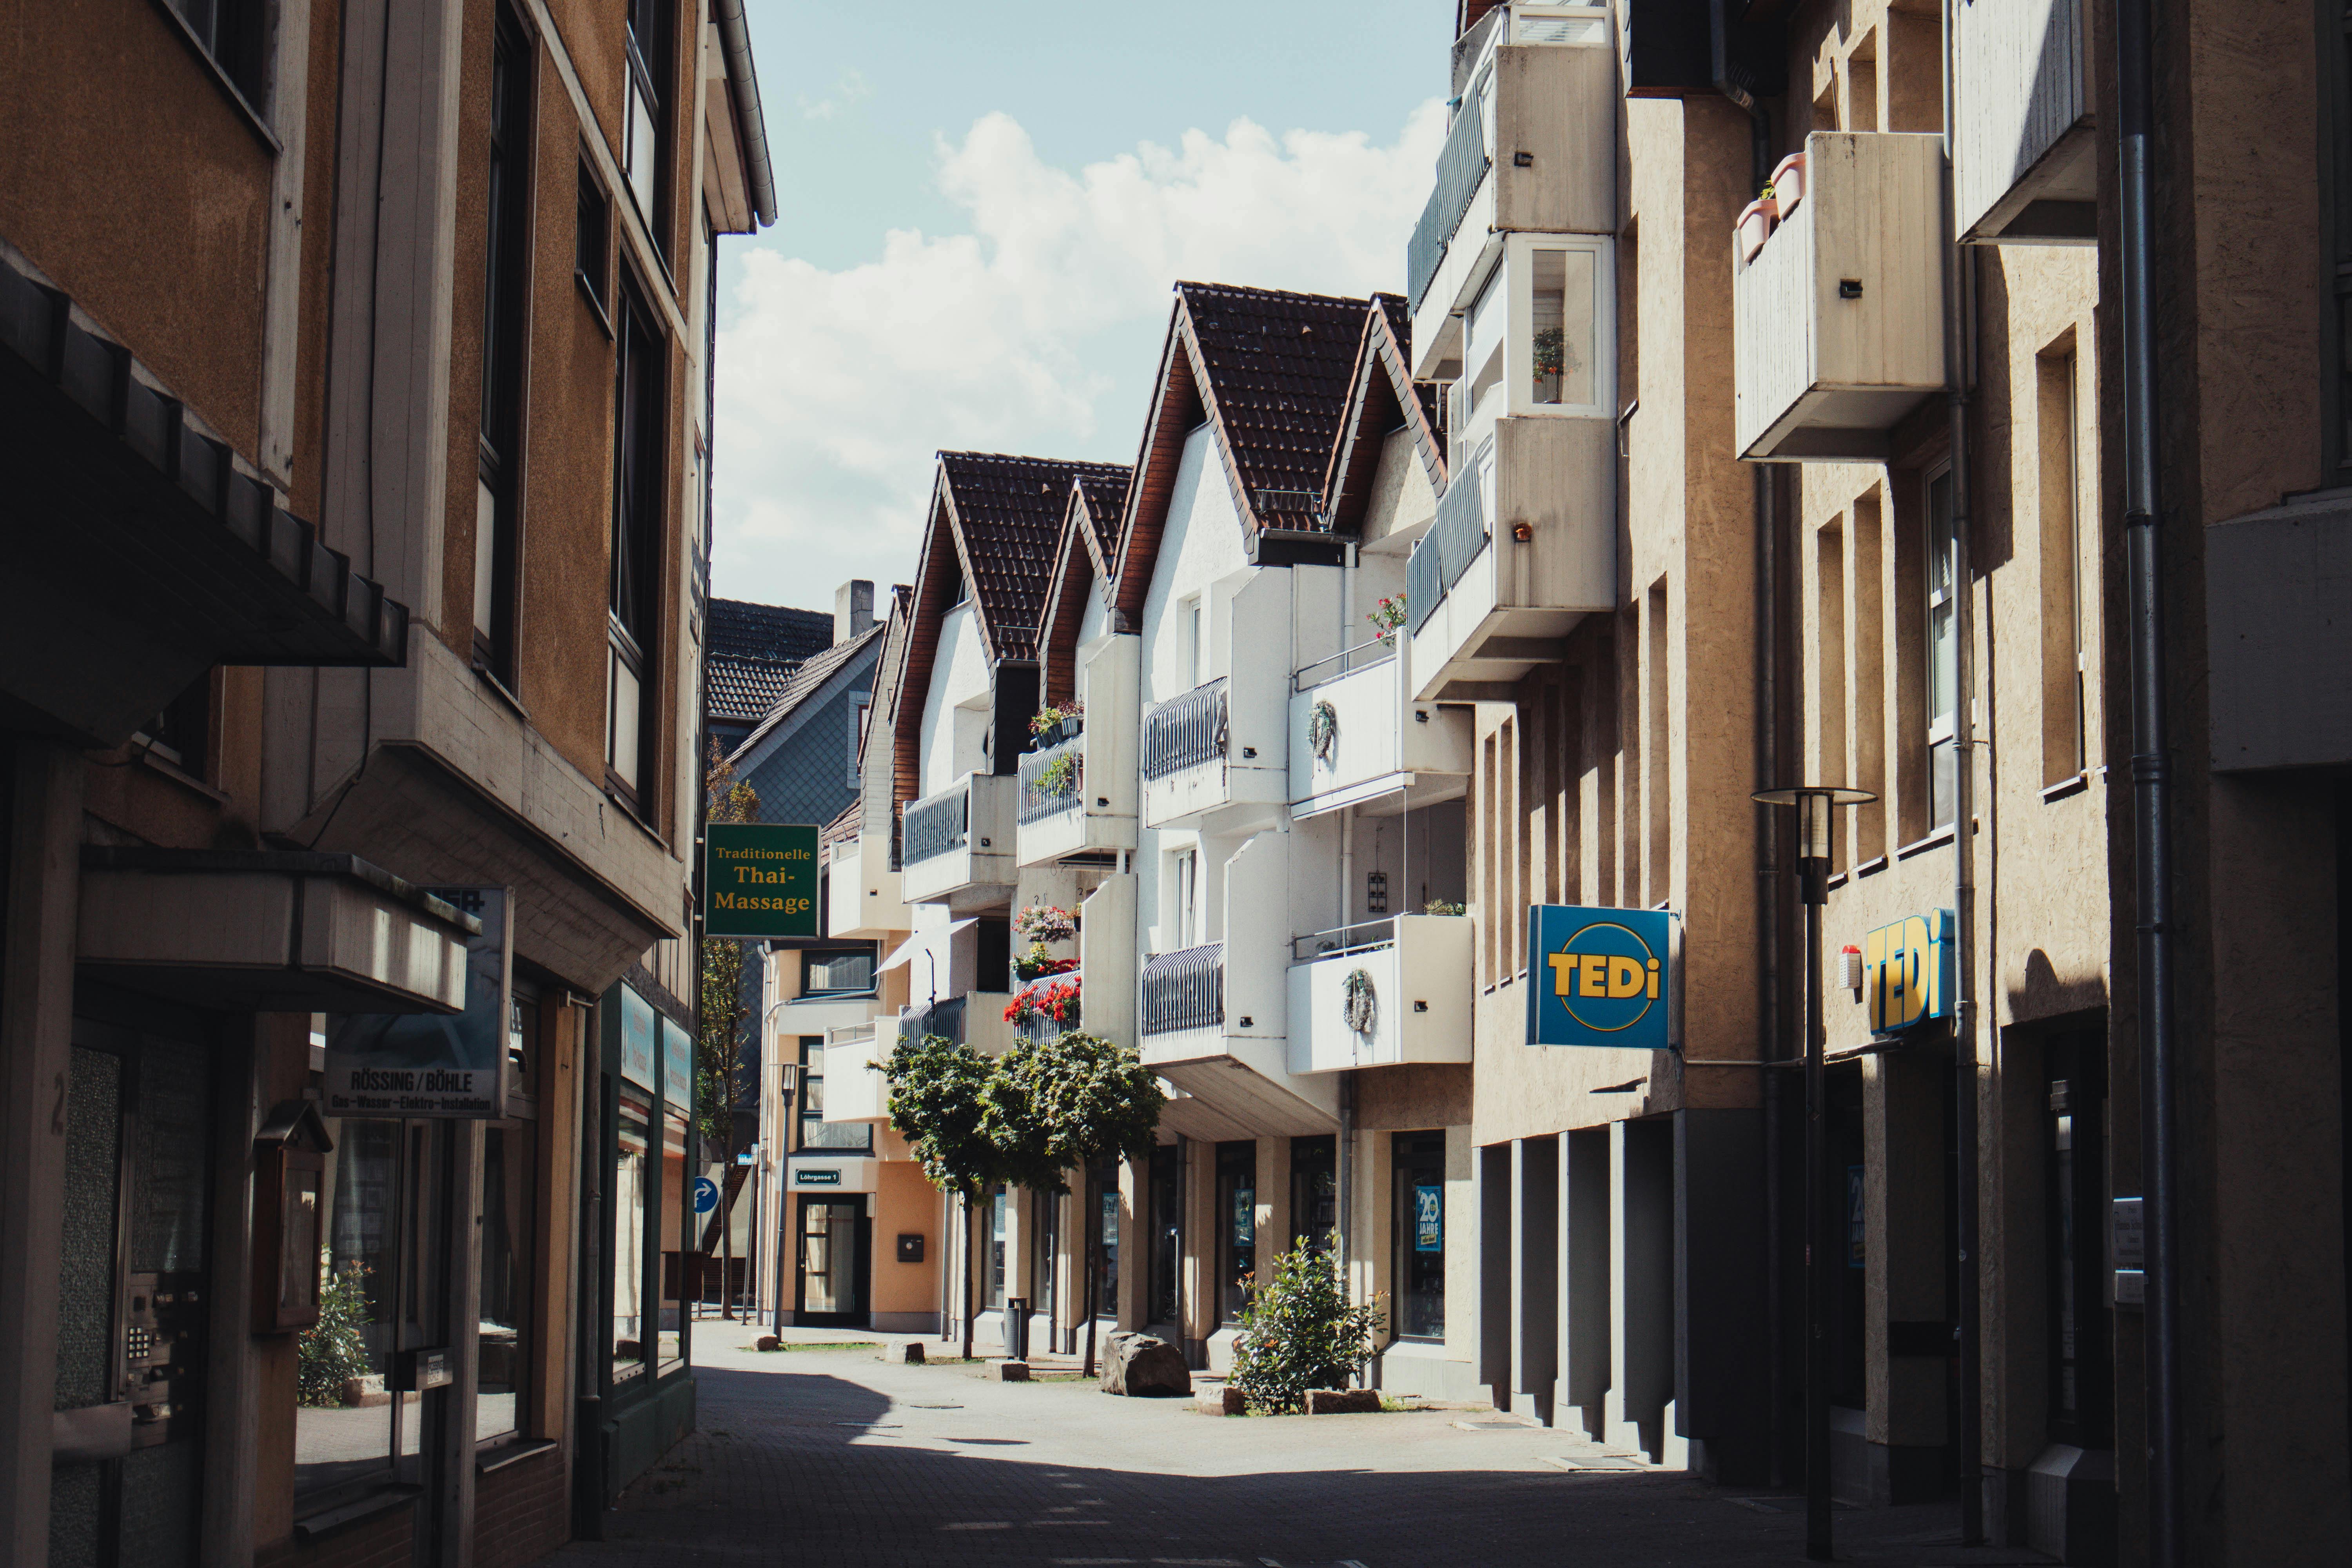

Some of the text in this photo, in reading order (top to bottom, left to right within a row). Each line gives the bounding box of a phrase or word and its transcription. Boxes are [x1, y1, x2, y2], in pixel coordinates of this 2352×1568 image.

[716, 848, 810, 860] Traditionelle
[734, 866, 795, 884] Thai-
[715, 892, 809, 914] Massage
[1548, 953, 1661, 1000] TEDi
[1867, 907, 1941, 1035] TEDi
[51, 1072, 64, 1136] 2
[1419, 1192, 1438, 1222] 20
[1419, 1223, 1438, 1235] JAHRE
